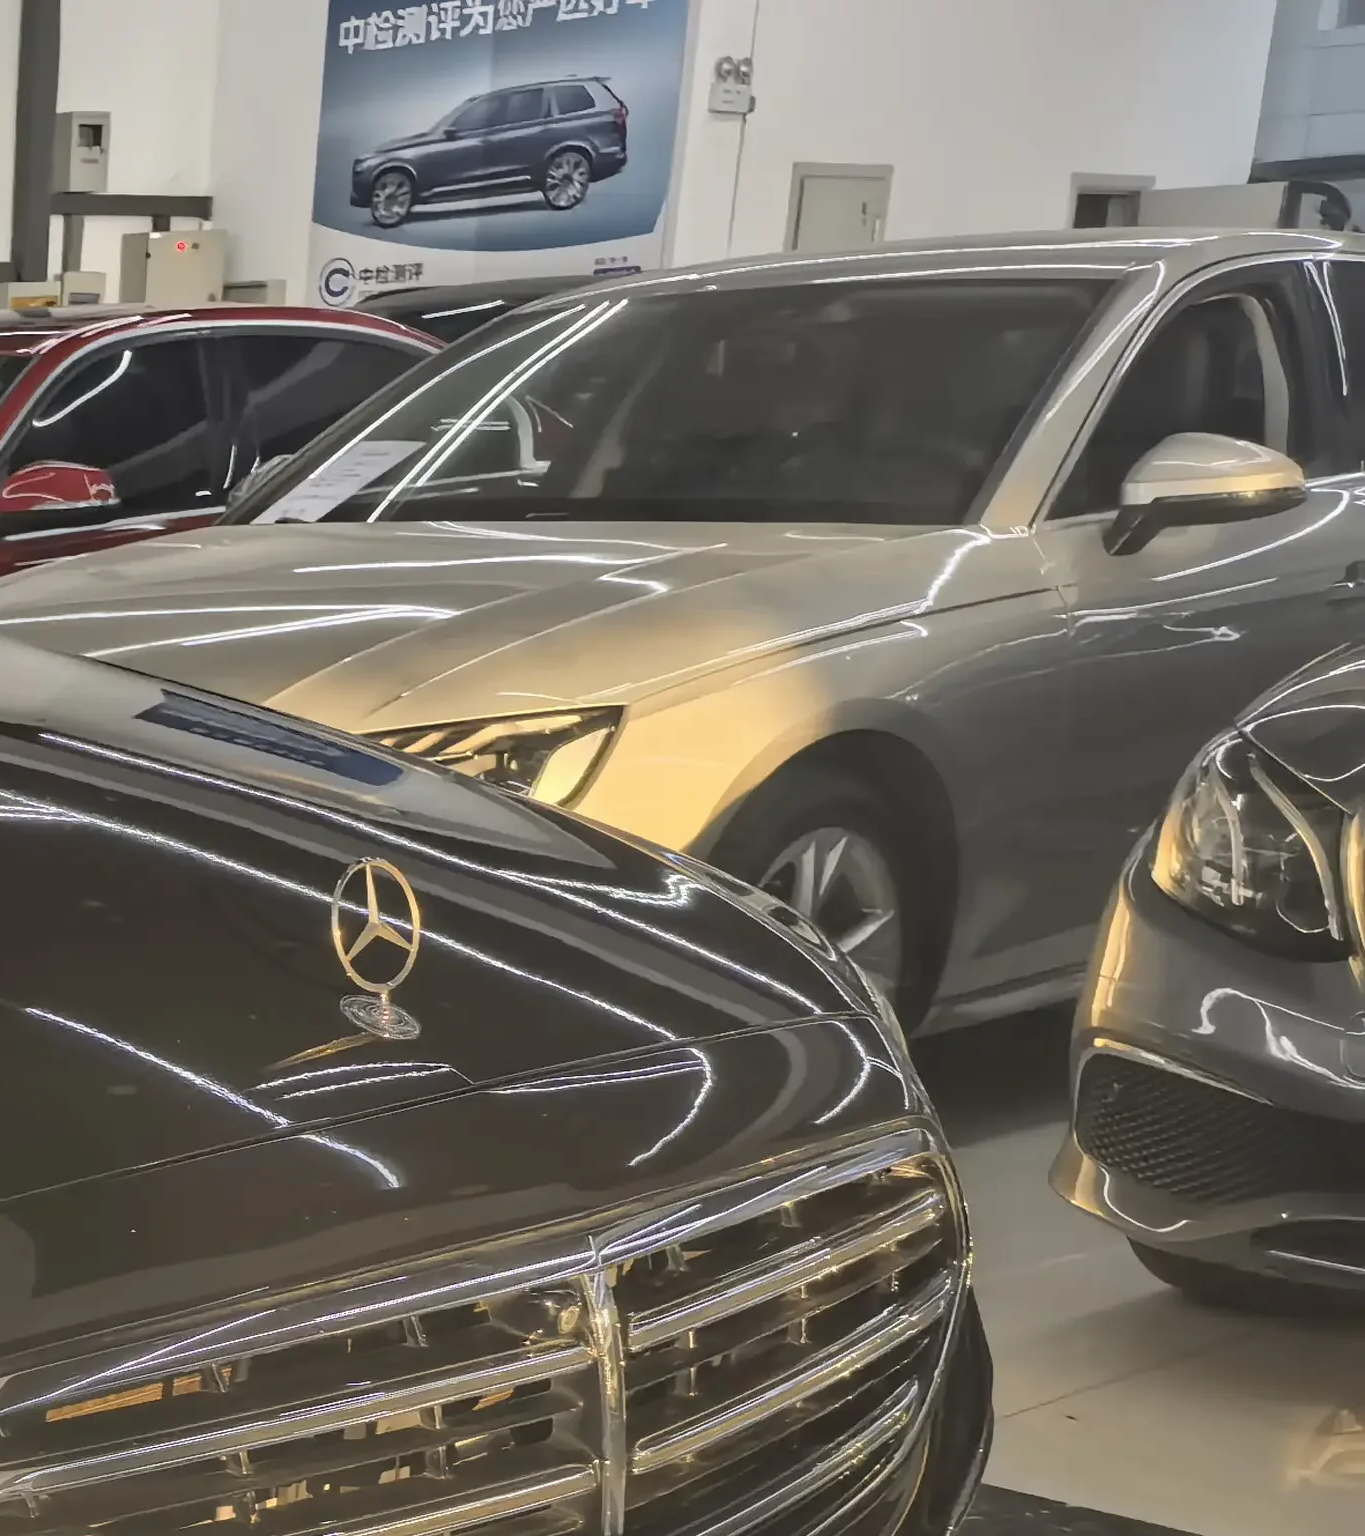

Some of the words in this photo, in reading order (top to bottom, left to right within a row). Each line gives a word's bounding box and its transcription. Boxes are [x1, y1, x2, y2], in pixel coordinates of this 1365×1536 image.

[339, 0, 654, 54] 中检测评为您
